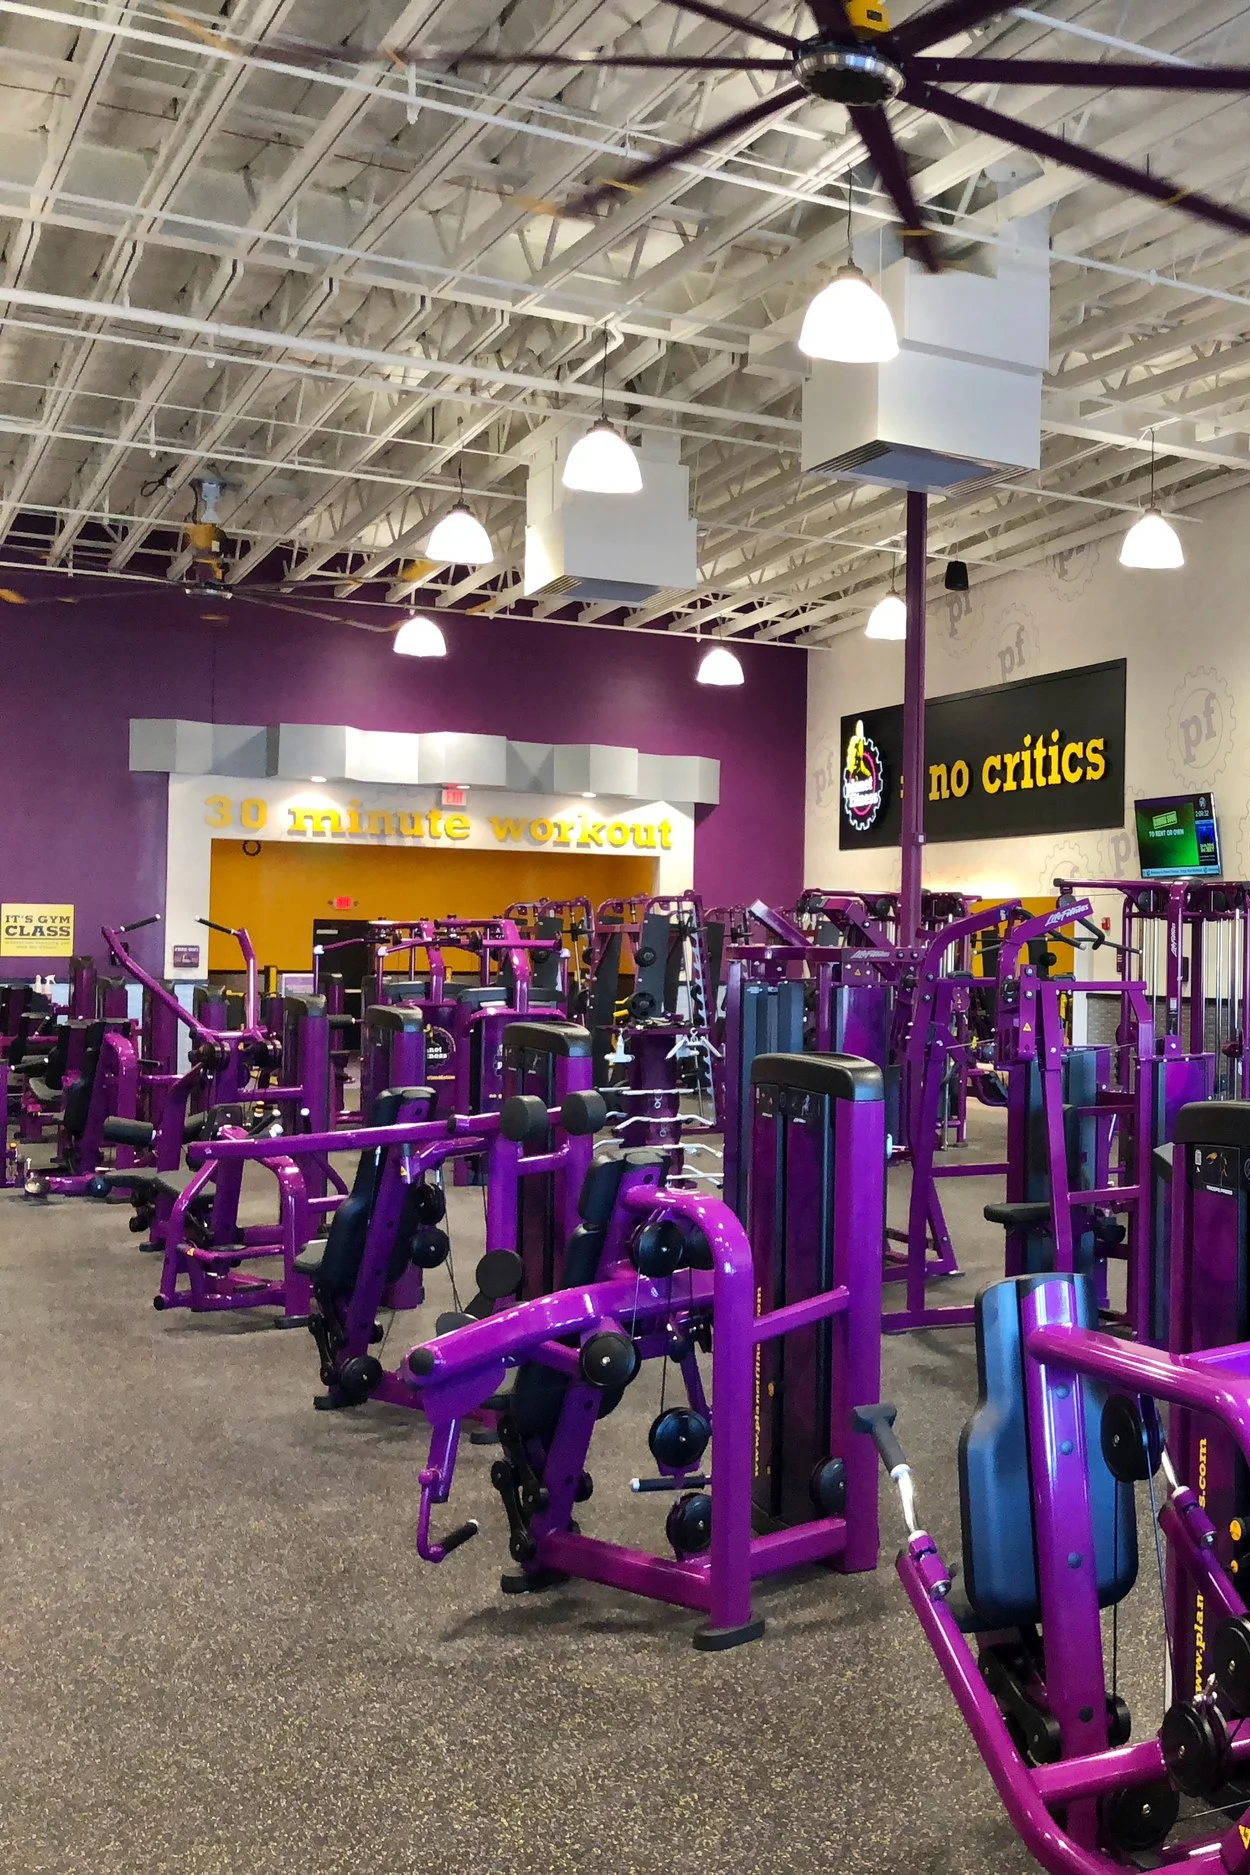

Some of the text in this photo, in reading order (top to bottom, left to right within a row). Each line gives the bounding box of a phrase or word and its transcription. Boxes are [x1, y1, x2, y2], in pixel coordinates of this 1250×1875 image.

[1180, 692, 1217, 765] pf
[928, 728, 1106, 801] no critics
[204, 794, 673, 848] 30 minute workout
[5, 915, 70, 924] IT'S GYM
[5, 925, 71, 937] CLASS
